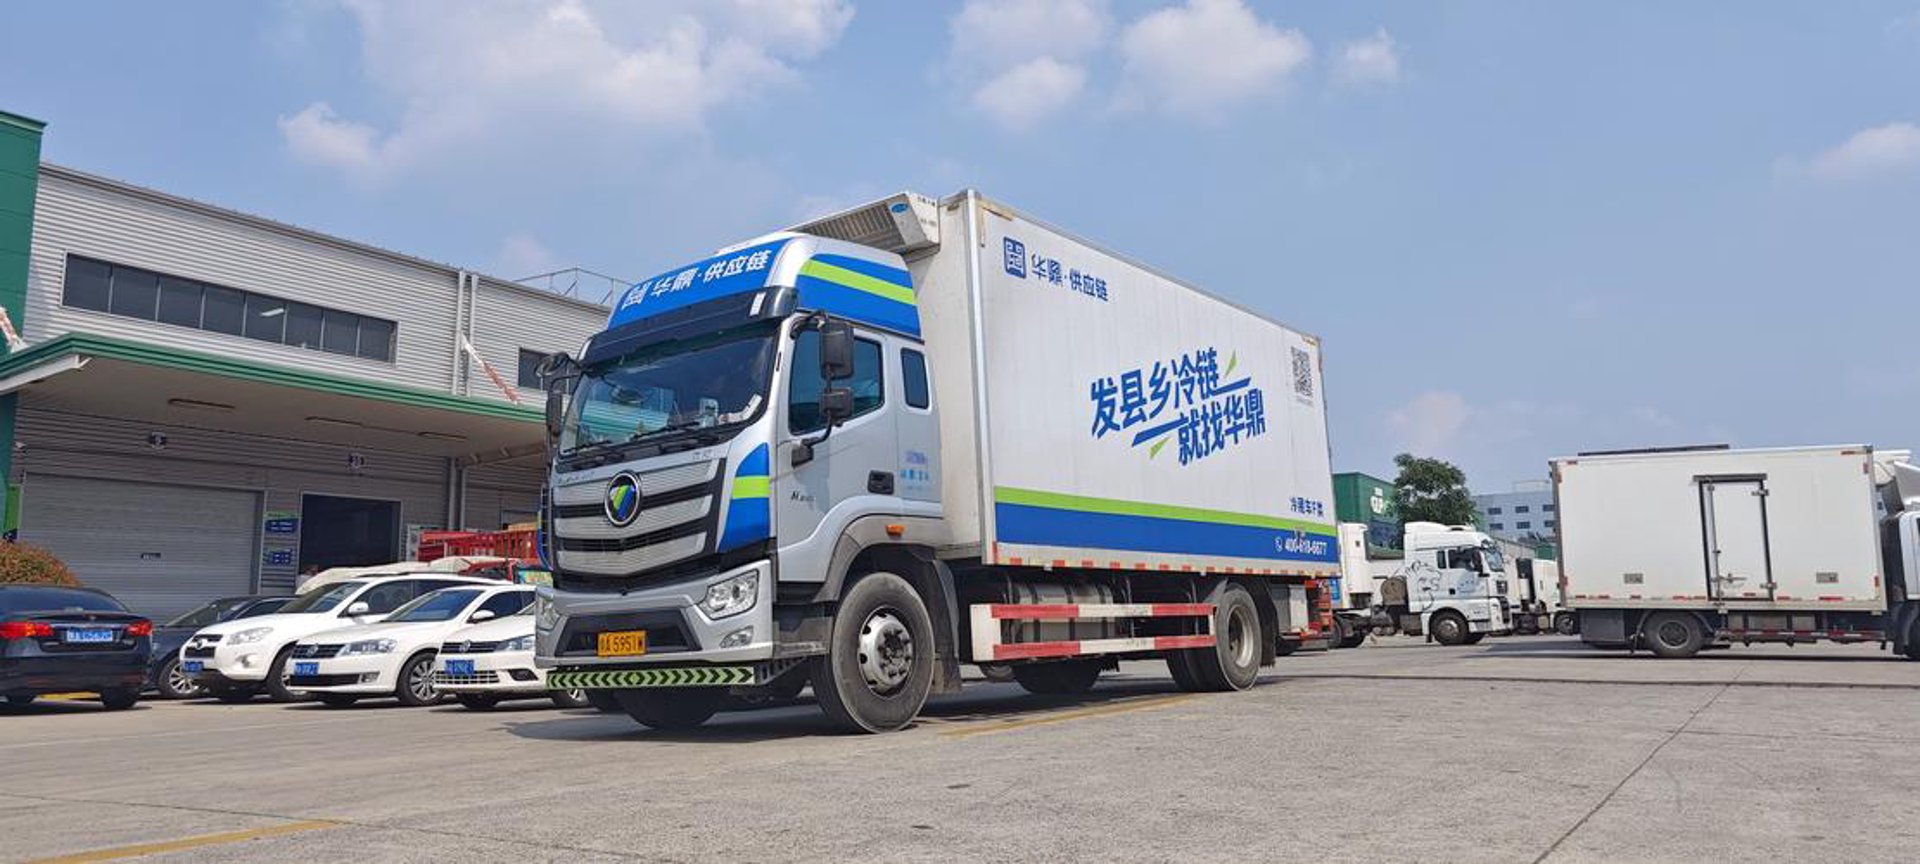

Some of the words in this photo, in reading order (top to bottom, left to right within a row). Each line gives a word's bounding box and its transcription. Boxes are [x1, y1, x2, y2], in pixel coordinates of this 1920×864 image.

[1090, 346, 1221, 439] 发县乡冷链
[1177, 387, 1266, 466] 就找华鼎
